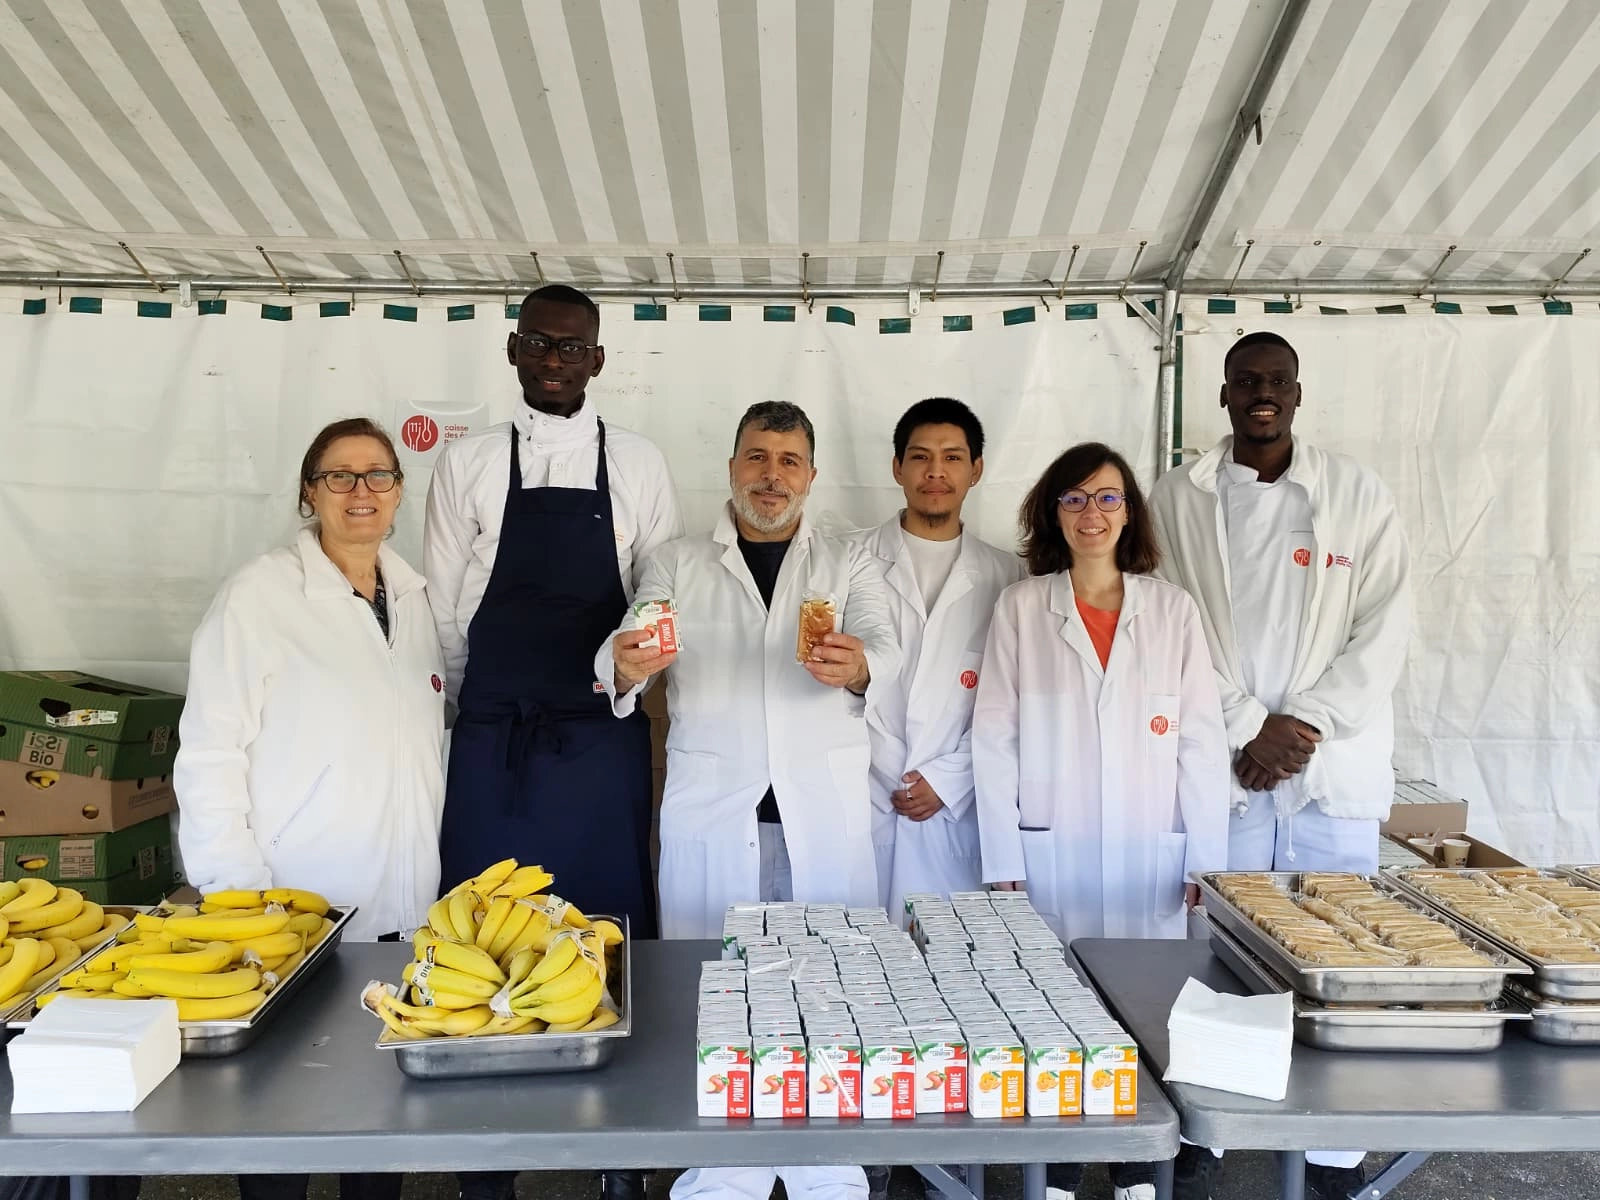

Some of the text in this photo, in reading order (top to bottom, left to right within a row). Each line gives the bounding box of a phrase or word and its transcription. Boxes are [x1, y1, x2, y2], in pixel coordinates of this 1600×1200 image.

[444, 424, 469, 432] caisse
[733, 1077, 745, 1102] POMME
[788, 1077, 799, 1102] POMME
[898, 1078, 910, 1104] POMME
[950, 1072, 962, 1097] POMME
[1008, 1076, 1018, 1103] ORANGE
[1064, 1076, 1075, 1102] ORANGE
[1120, 1075, 1131, 1100] ORANGE
